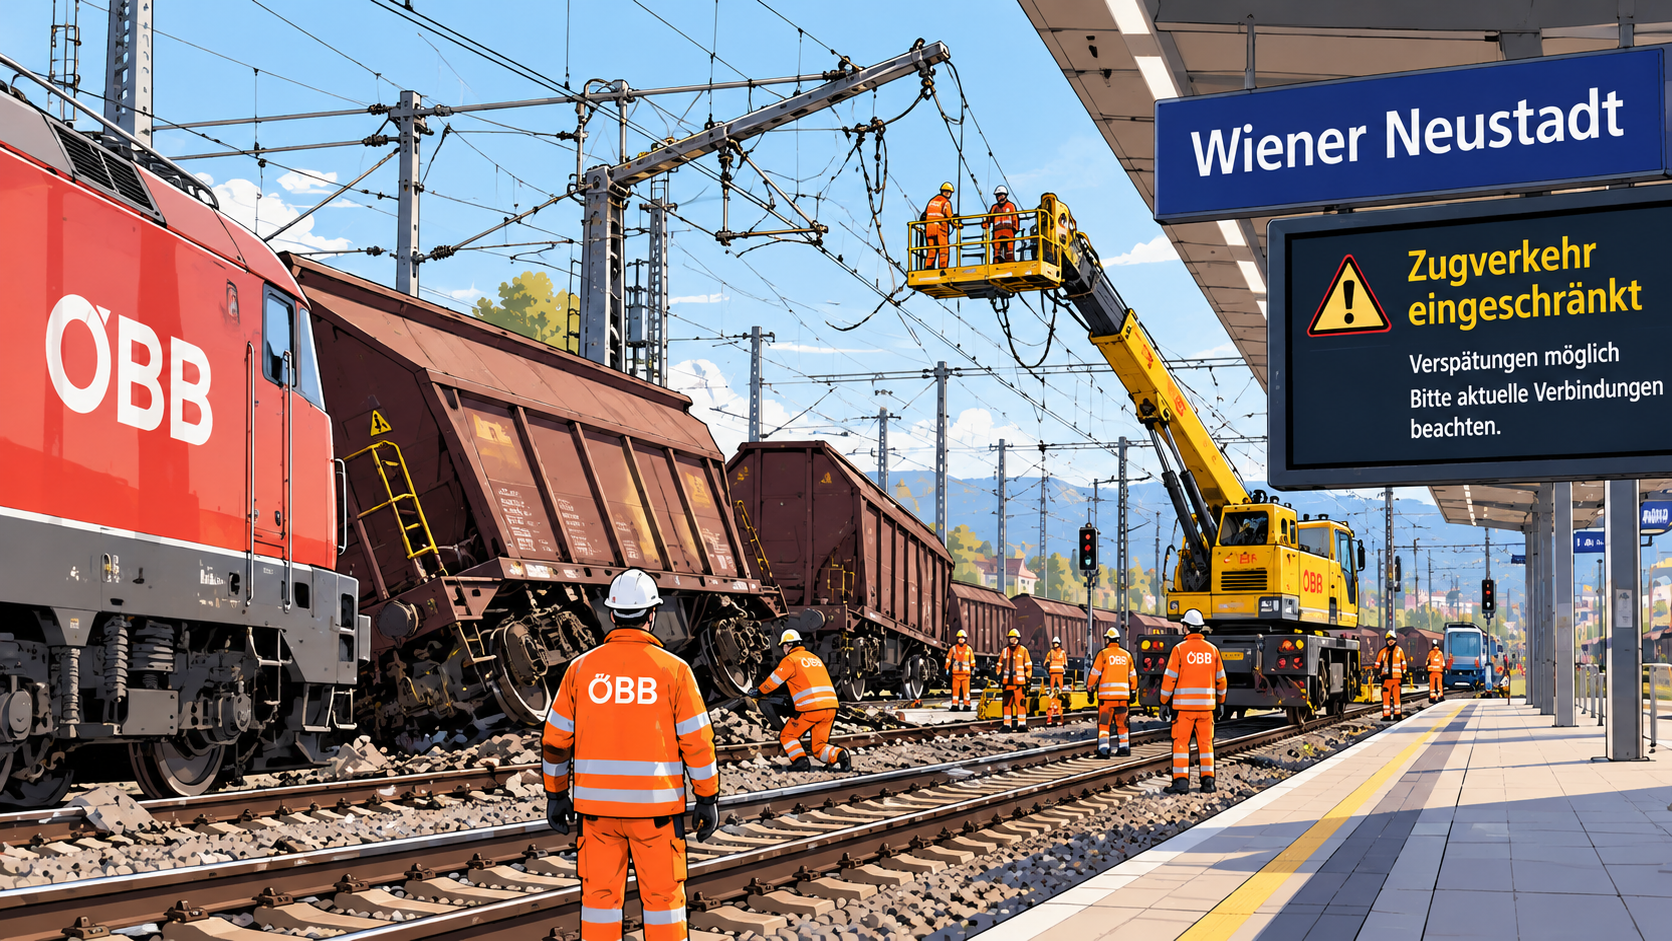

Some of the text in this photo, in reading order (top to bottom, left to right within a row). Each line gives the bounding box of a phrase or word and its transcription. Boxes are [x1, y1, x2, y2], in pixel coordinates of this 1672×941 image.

[1191, 87, 1624, 177] Wiener Neustadt
[1408, 236, 1597, 287] Zugverkehr
[1409, 278, 1643, 331] eingeschränkt
[1410, 341, 1620, 376] Verspätungen möglich
[1410, 377, 1664, 409] Bitte aktuelle Verbindungen
[1410, 417, 1501, 440] beachten.
[588, 670, 658, 705] ÖBB
